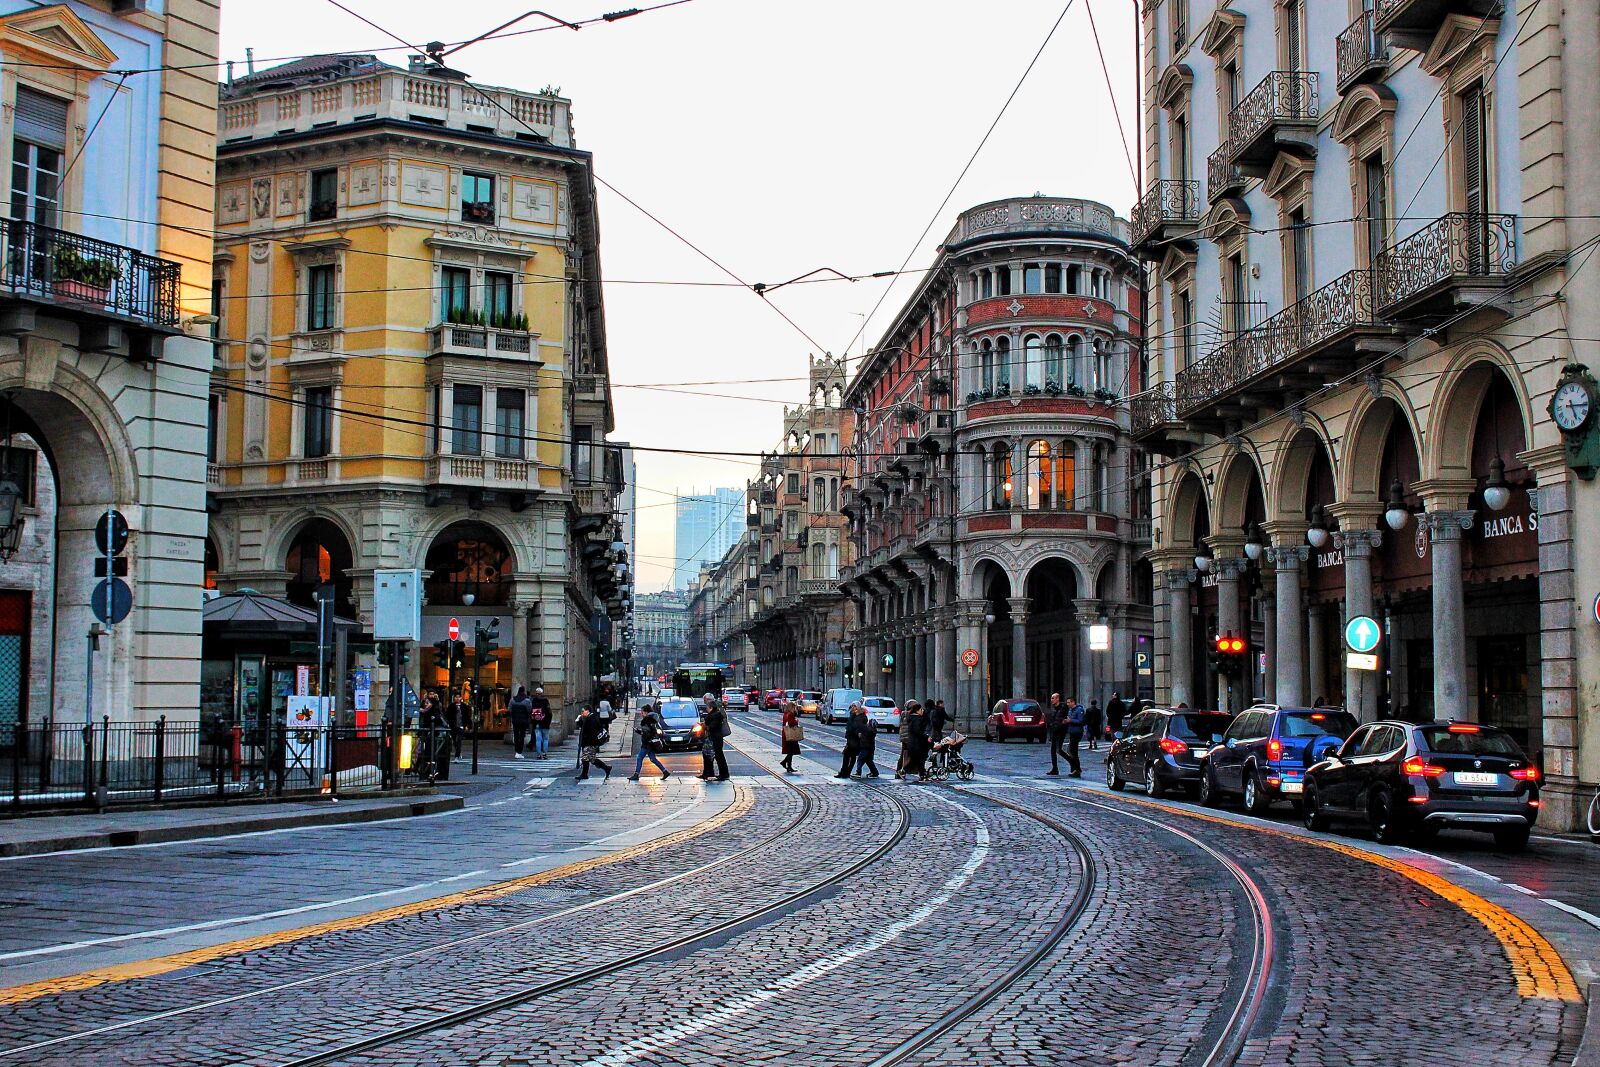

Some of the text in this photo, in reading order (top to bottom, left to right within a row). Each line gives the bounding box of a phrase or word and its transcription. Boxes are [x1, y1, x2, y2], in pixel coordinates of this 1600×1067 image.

[1483, 512, 1539, 538] BANCA S
[1317, 551, 1344, 568] BANCA
[1137, 653, 1147, 667] P
